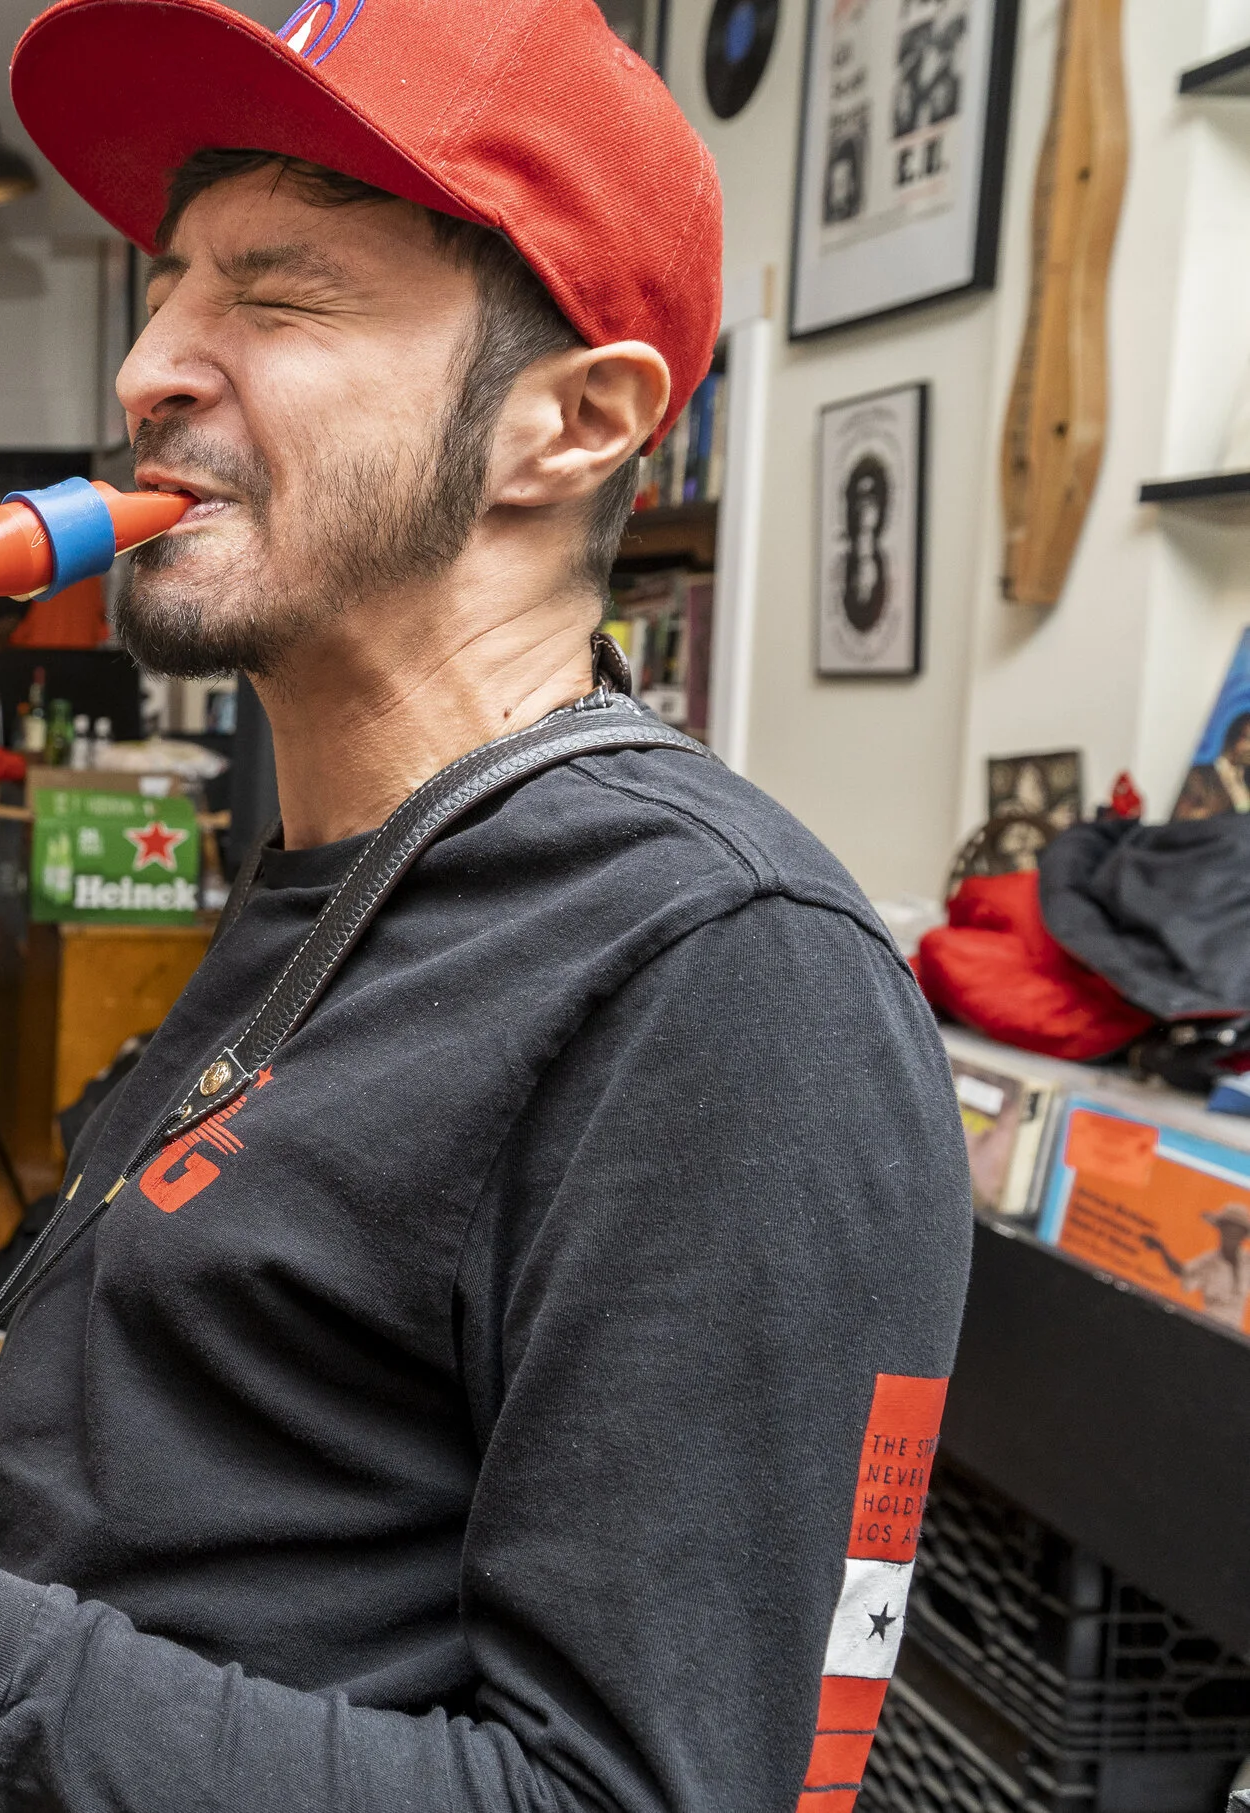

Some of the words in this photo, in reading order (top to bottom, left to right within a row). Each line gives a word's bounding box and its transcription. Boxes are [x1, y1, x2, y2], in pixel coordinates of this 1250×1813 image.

[873, 1434, 907, 1456] THE
[863, 1492, 915, 1515] HOLD
[856, 1523, 893, 1543] LOS
